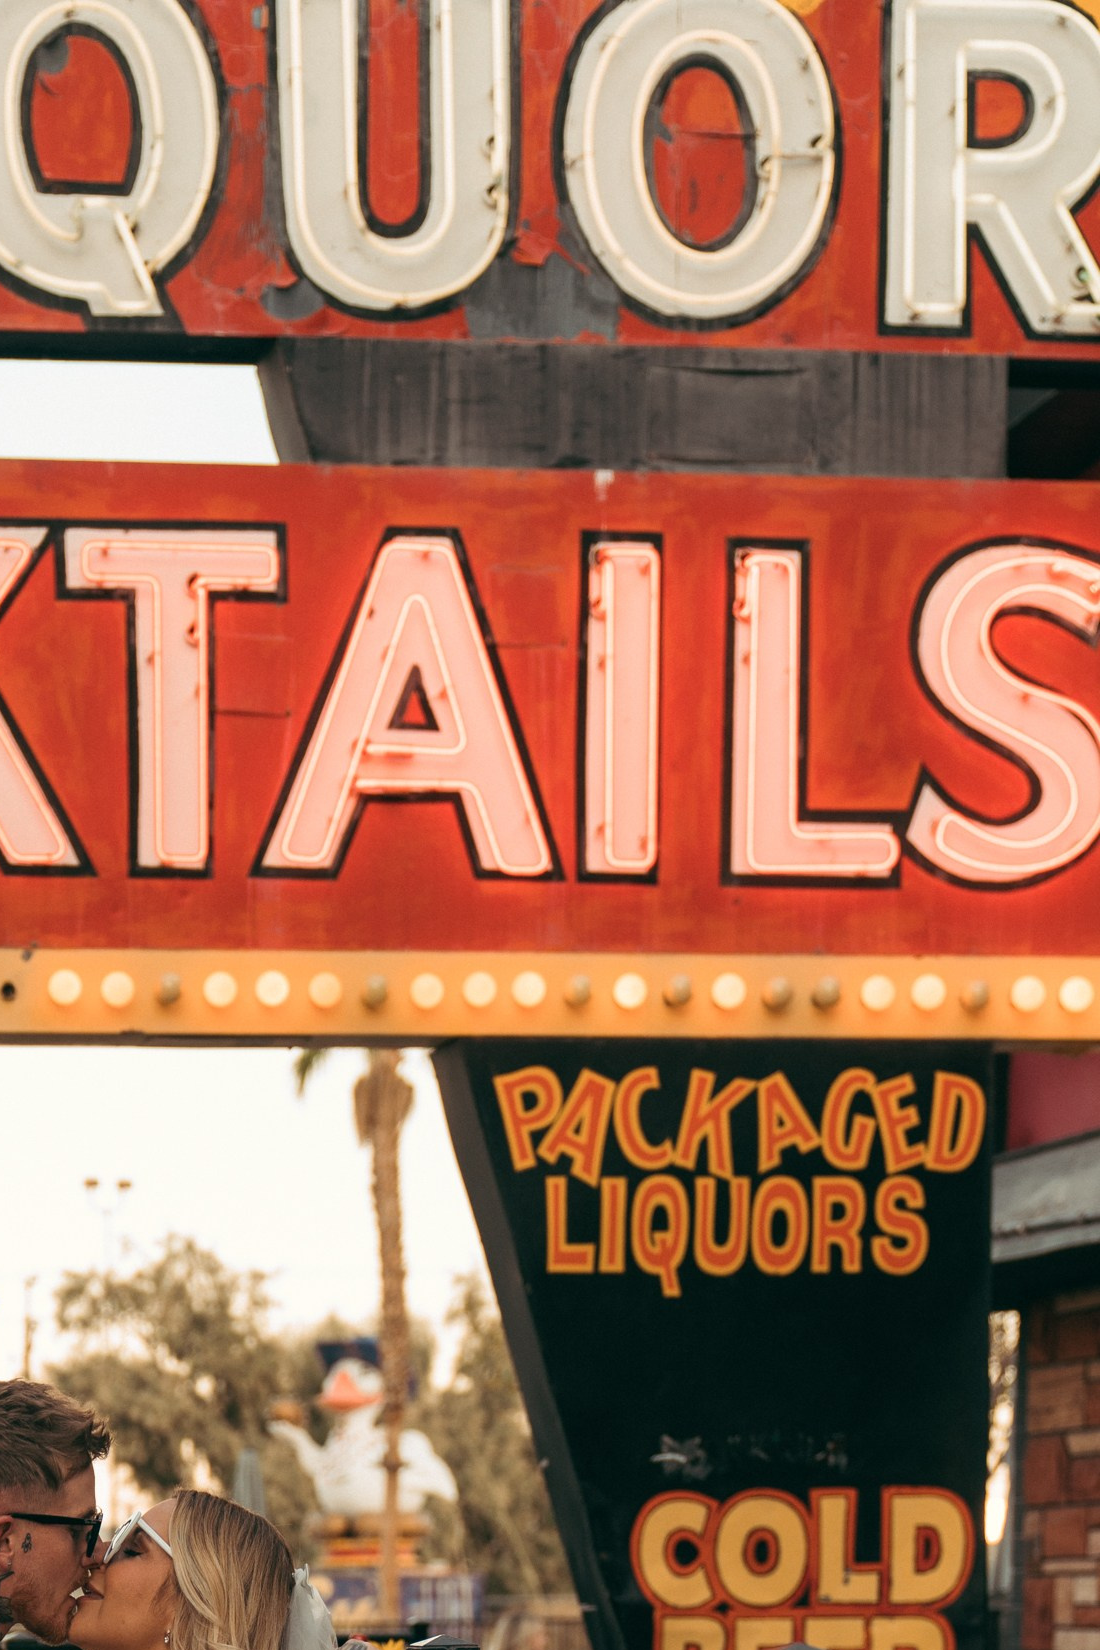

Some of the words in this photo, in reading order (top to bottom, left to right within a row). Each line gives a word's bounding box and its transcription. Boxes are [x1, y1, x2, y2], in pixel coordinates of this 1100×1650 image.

[493, 1066, 986, 1187] PACKAGED
[545, 1174, 929, 1298] LIQUORS
[630, 1485, 974, 1610] COLD
